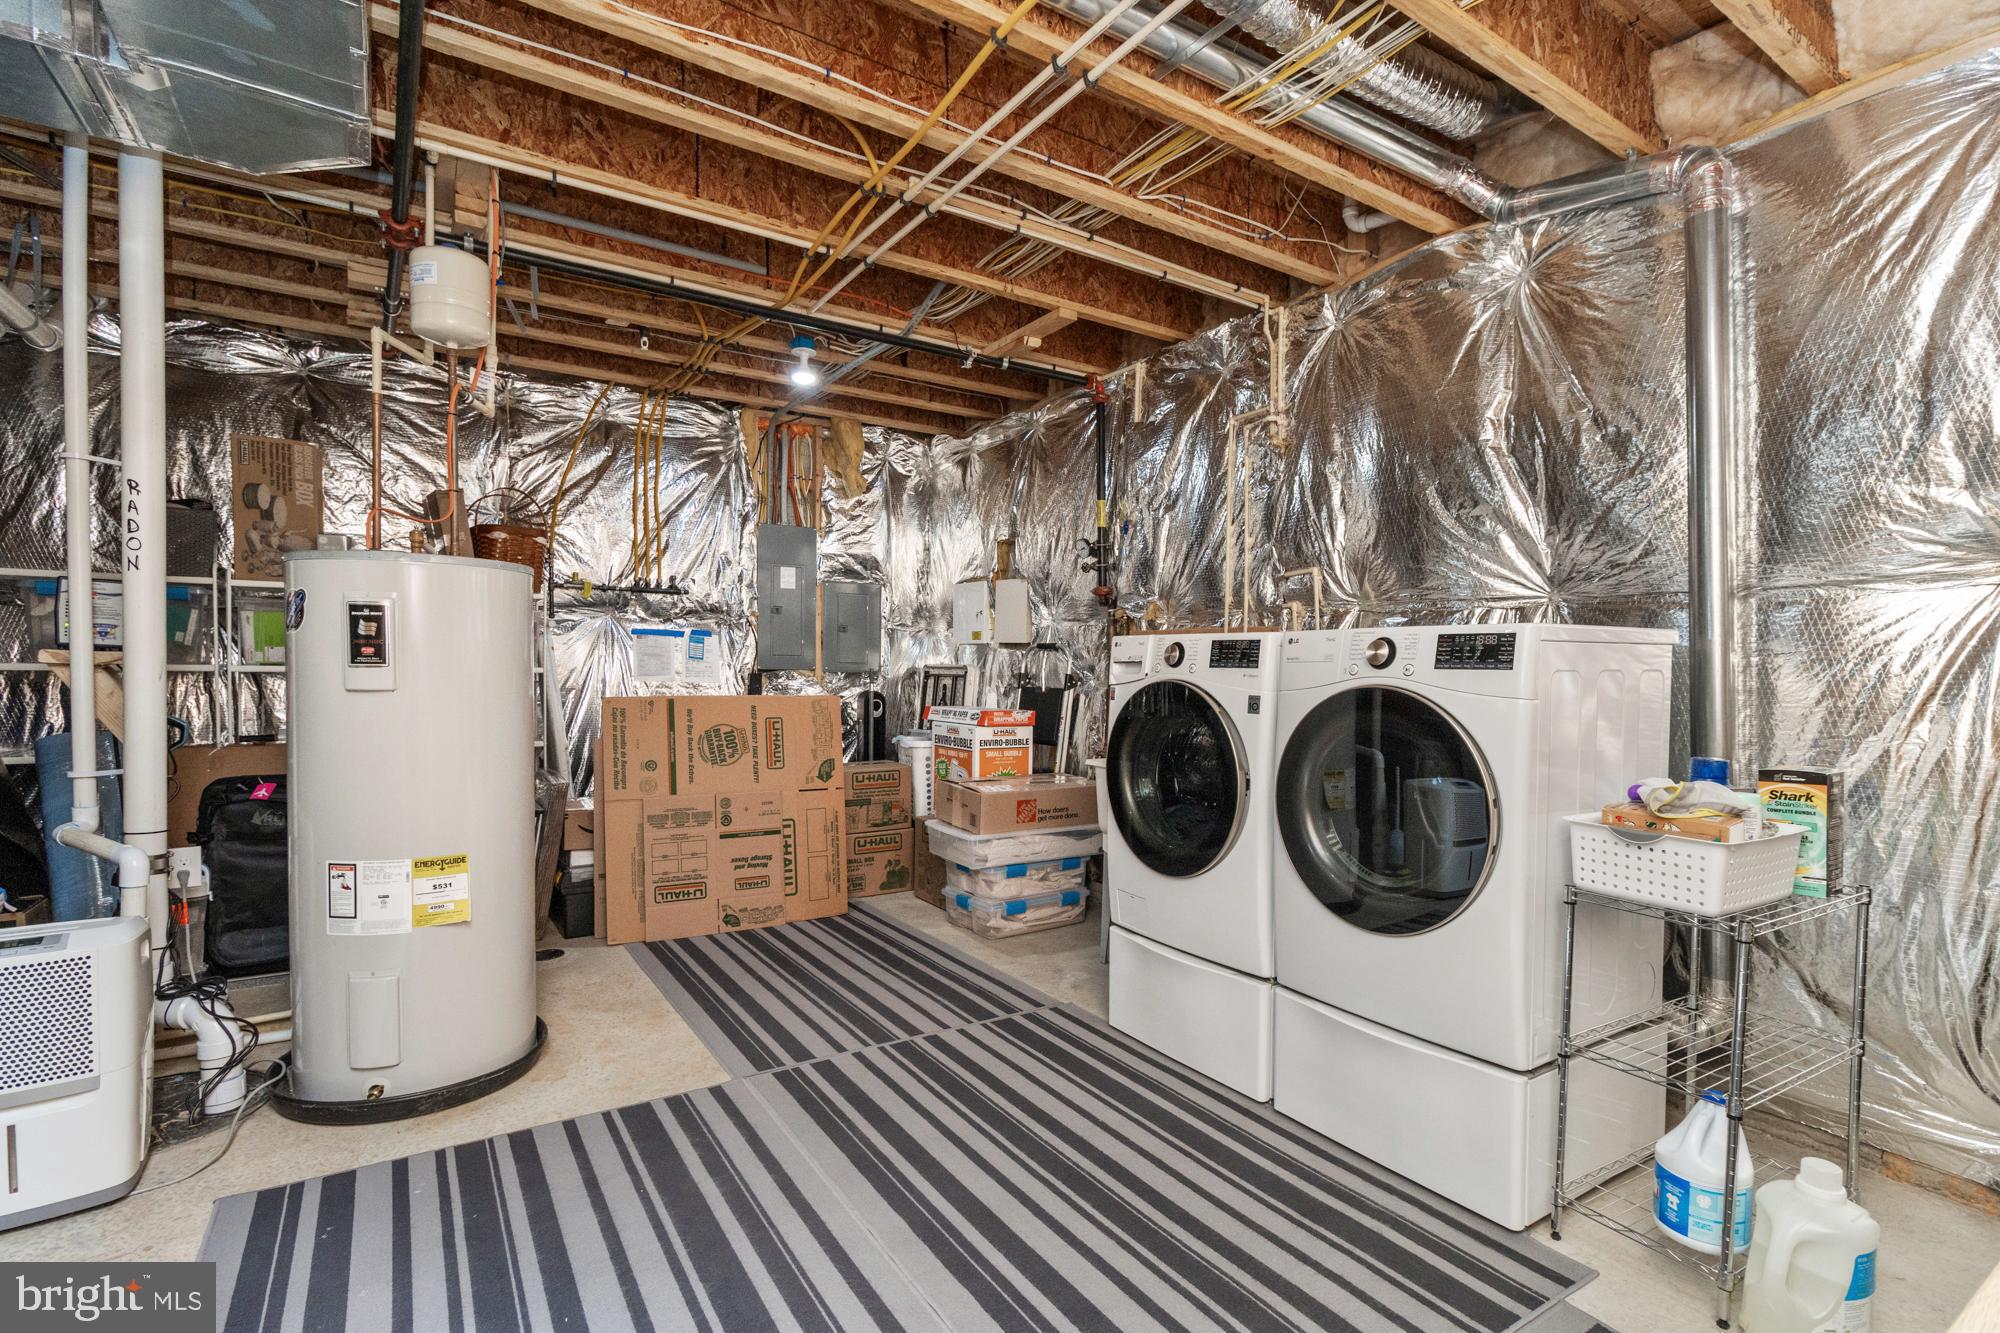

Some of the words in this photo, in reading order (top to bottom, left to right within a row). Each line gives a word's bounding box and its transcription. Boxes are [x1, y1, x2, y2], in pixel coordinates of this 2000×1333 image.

[296, 480, 314, 508] BOX
[126, 478, 142, 572] RADON
[705, 730, 718, 766] GUARANTEE
[713, 728, 727, 764] BUY-BACK
[723, 729, 738, 758] 100%
[772, 720, 781, 766] U-HAUL
[935, 734, 972, 749] ENVIRO-BUBBLE
[980, 738, 1029, 747] ENVIRO-BUBBLE
[855, 773, 897, 784] U-HAUL
[1768, 790, 1814, 802] Shark
[857, 836, 899, 848] U-HAUL
[414, 856, 466, 870] ENERGYGUIDE
[658, 889, 703, 900] U-HAUL
